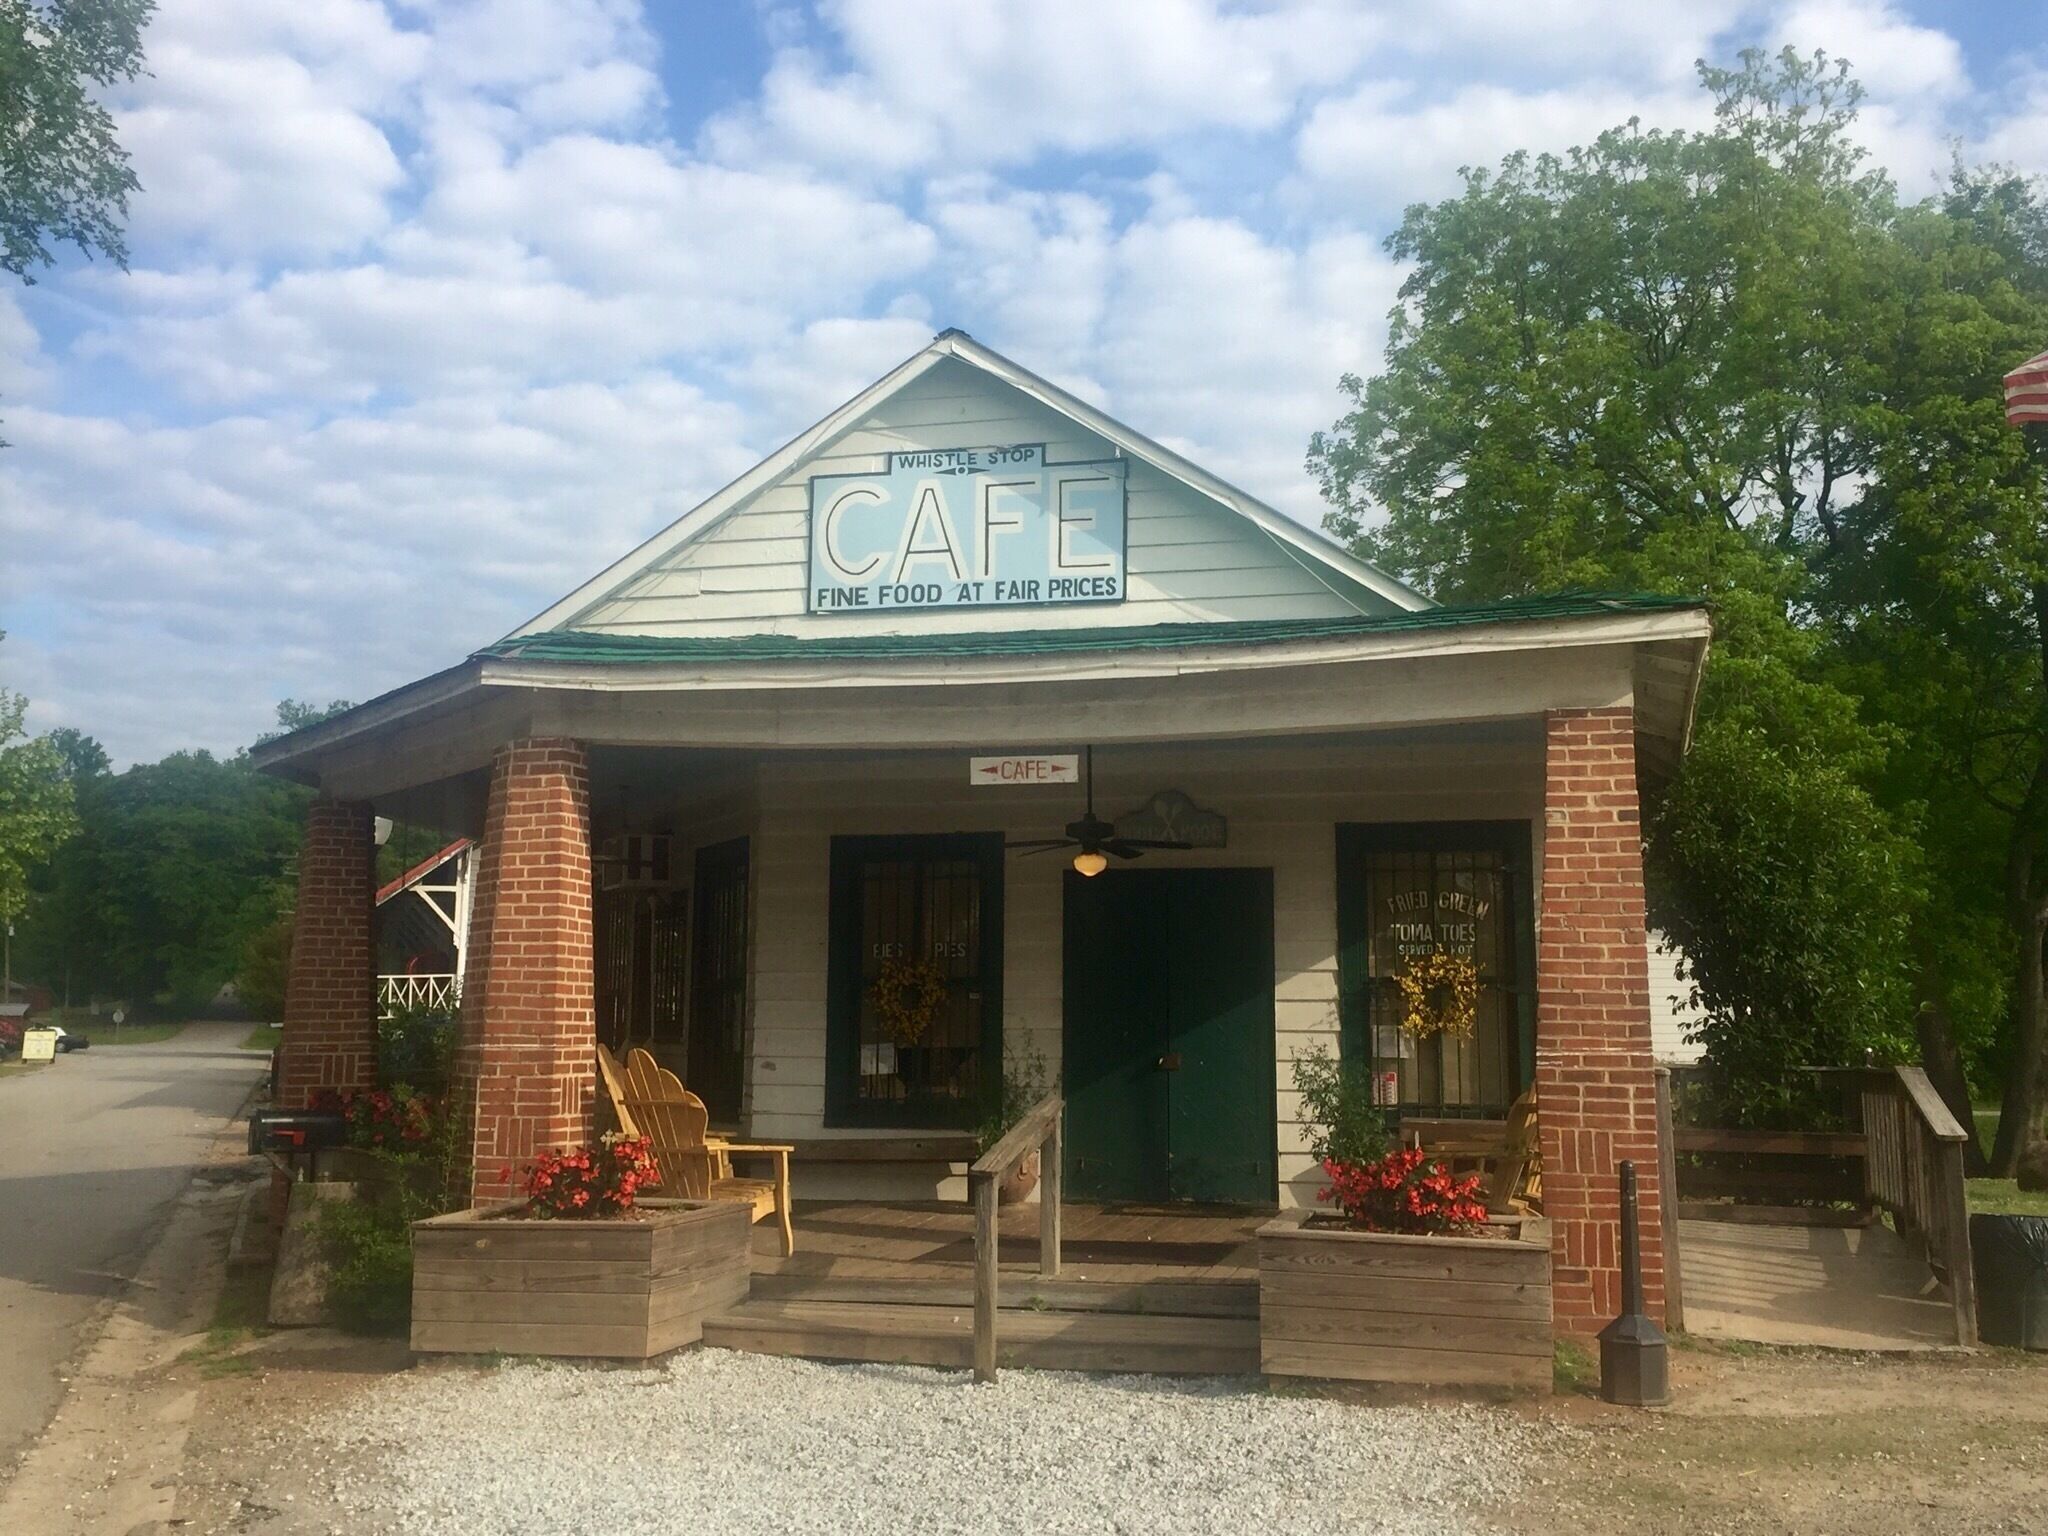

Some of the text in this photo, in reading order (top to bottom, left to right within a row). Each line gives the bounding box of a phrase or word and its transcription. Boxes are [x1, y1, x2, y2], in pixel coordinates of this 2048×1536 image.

[899, 449, 1035, 469] WHISTLE STOP
[815, 471, 1117, 585] CAFE
[817, 576, 1117, 607] FINE FOOD AT FAIR PRICES
[1001, 760, 1048, 780] CAFE
[1387, 890, 1490, 920] FRIED GREEN
